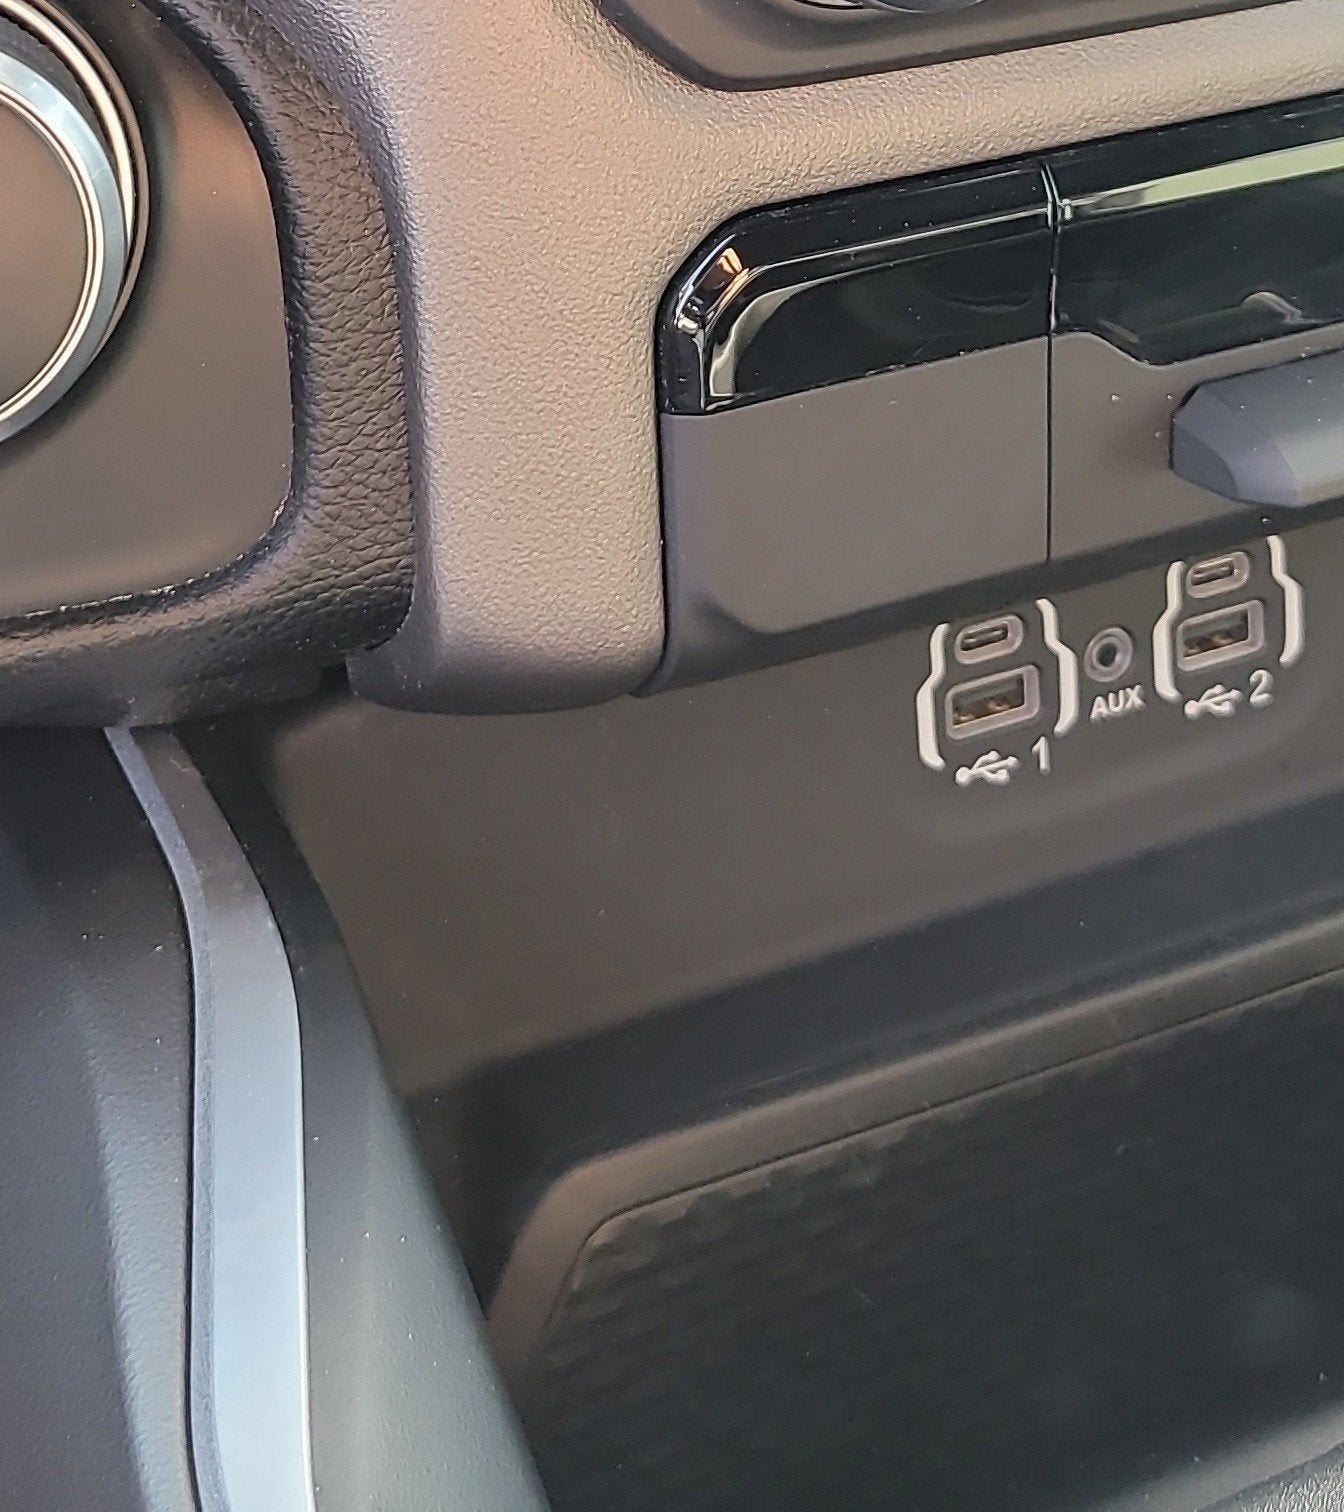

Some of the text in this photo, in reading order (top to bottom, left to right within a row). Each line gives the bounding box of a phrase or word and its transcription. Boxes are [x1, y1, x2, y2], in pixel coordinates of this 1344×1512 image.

[1090, 685, 1147, 720] AUX
[1249, 669, 1274, 707] 2
[1031, 735, 1051, 774] 1
